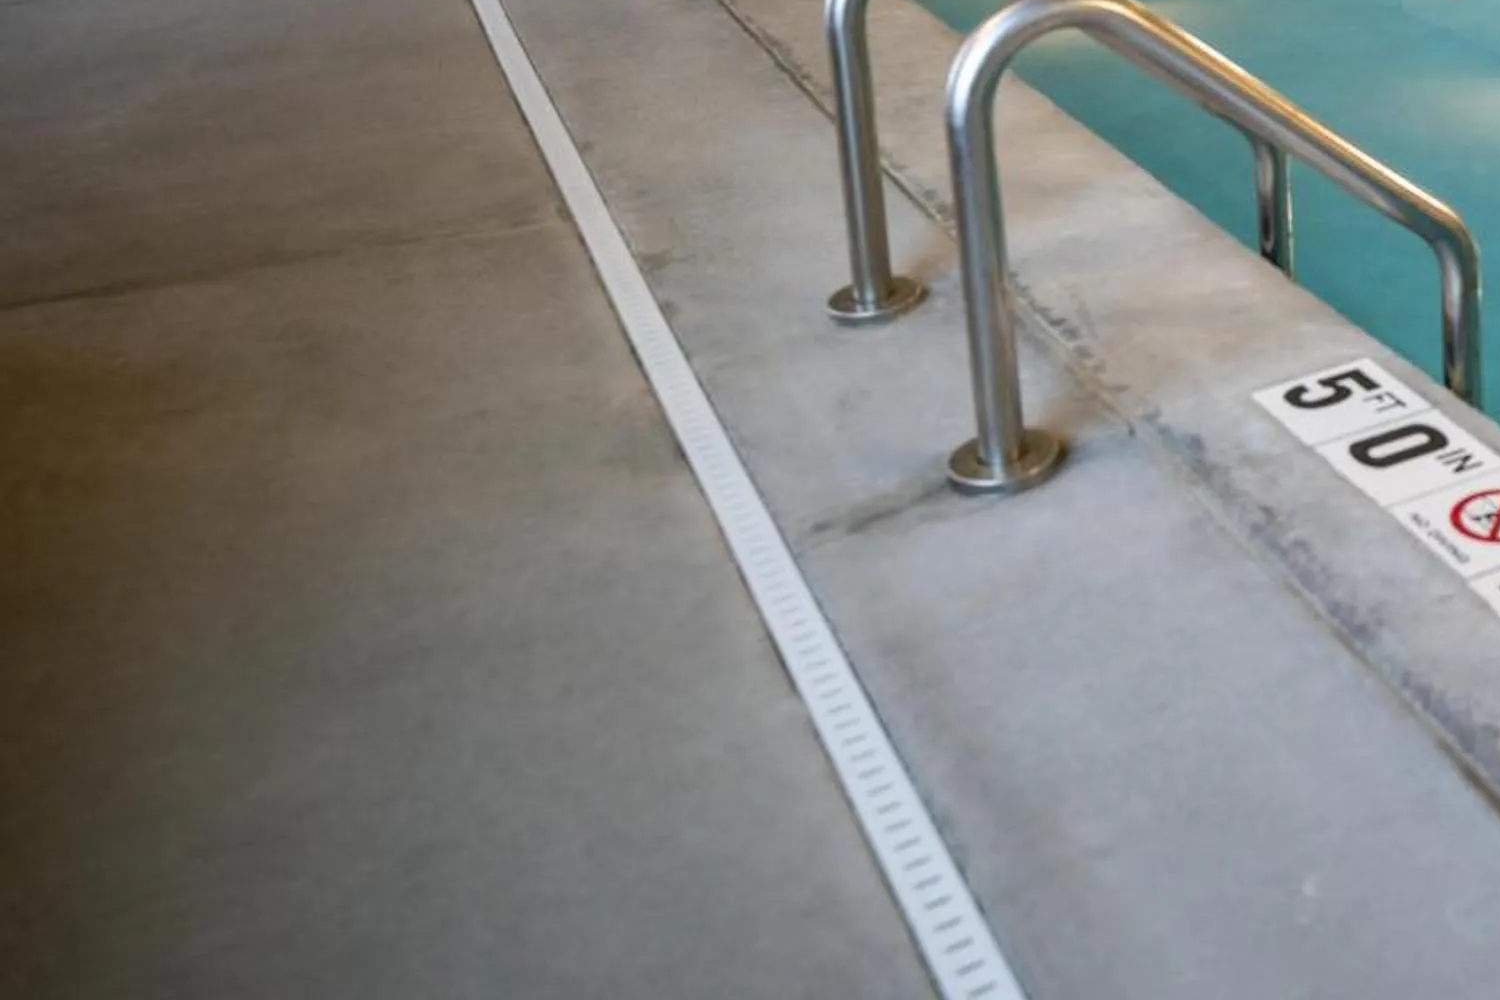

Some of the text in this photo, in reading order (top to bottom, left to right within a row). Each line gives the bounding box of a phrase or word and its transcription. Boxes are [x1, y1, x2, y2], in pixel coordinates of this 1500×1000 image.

[1283, 368, 1407, 414] 5 FT
[1349, 423, 1484, 474] 0 IN
